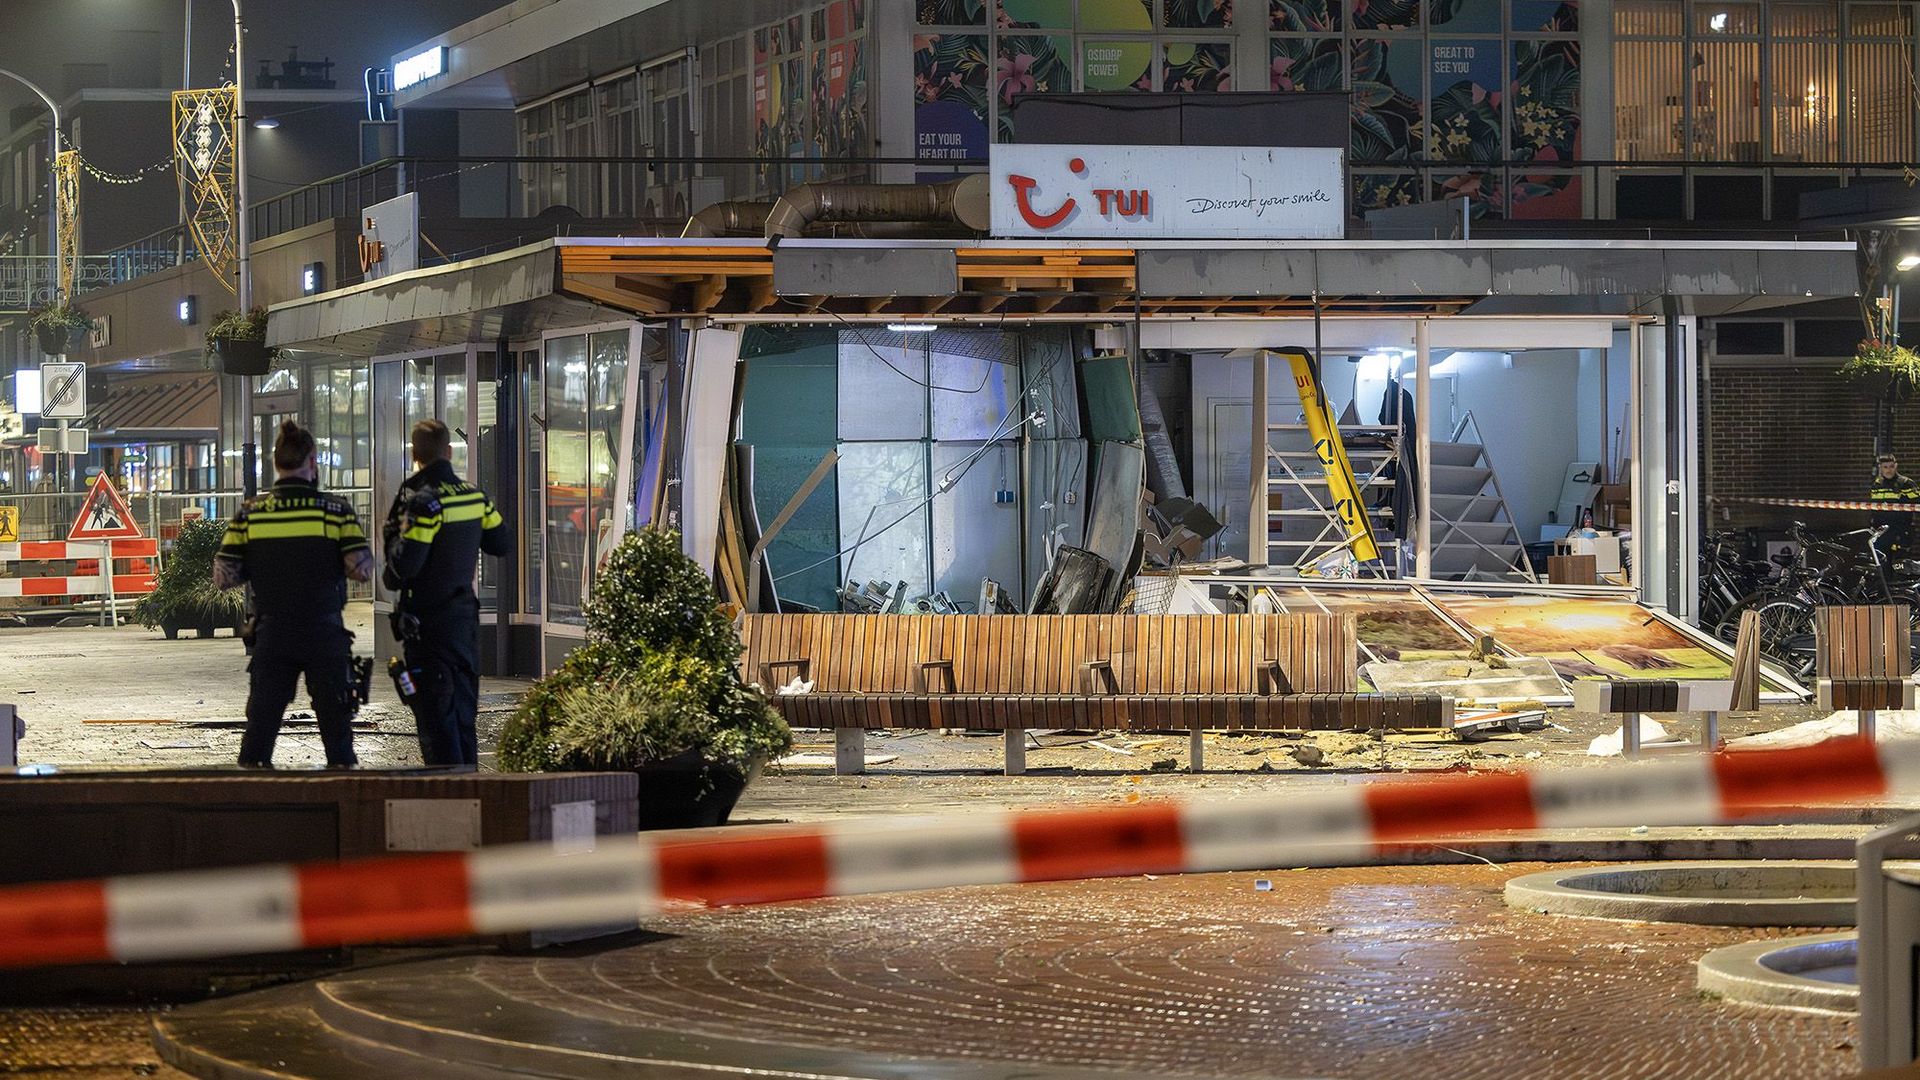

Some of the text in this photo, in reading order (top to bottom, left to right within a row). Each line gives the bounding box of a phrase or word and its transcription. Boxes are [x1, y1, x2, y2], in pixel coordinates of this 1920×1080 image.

[1087, 49, 1122, 61] OSDORP
[1434, 47, 1475, 58] GREAT TO
[1087, 64, 1119, 76] POWER
[1434, 61, 1469, 73] SEE YOU
[919, 133, 962, 146] EAT YOUR
[919, 148, 968, 159] HEART OUT
[1092, 189, 1330, 217] TUI Discover your smile
[1294, 375, 1310, 389] UI
